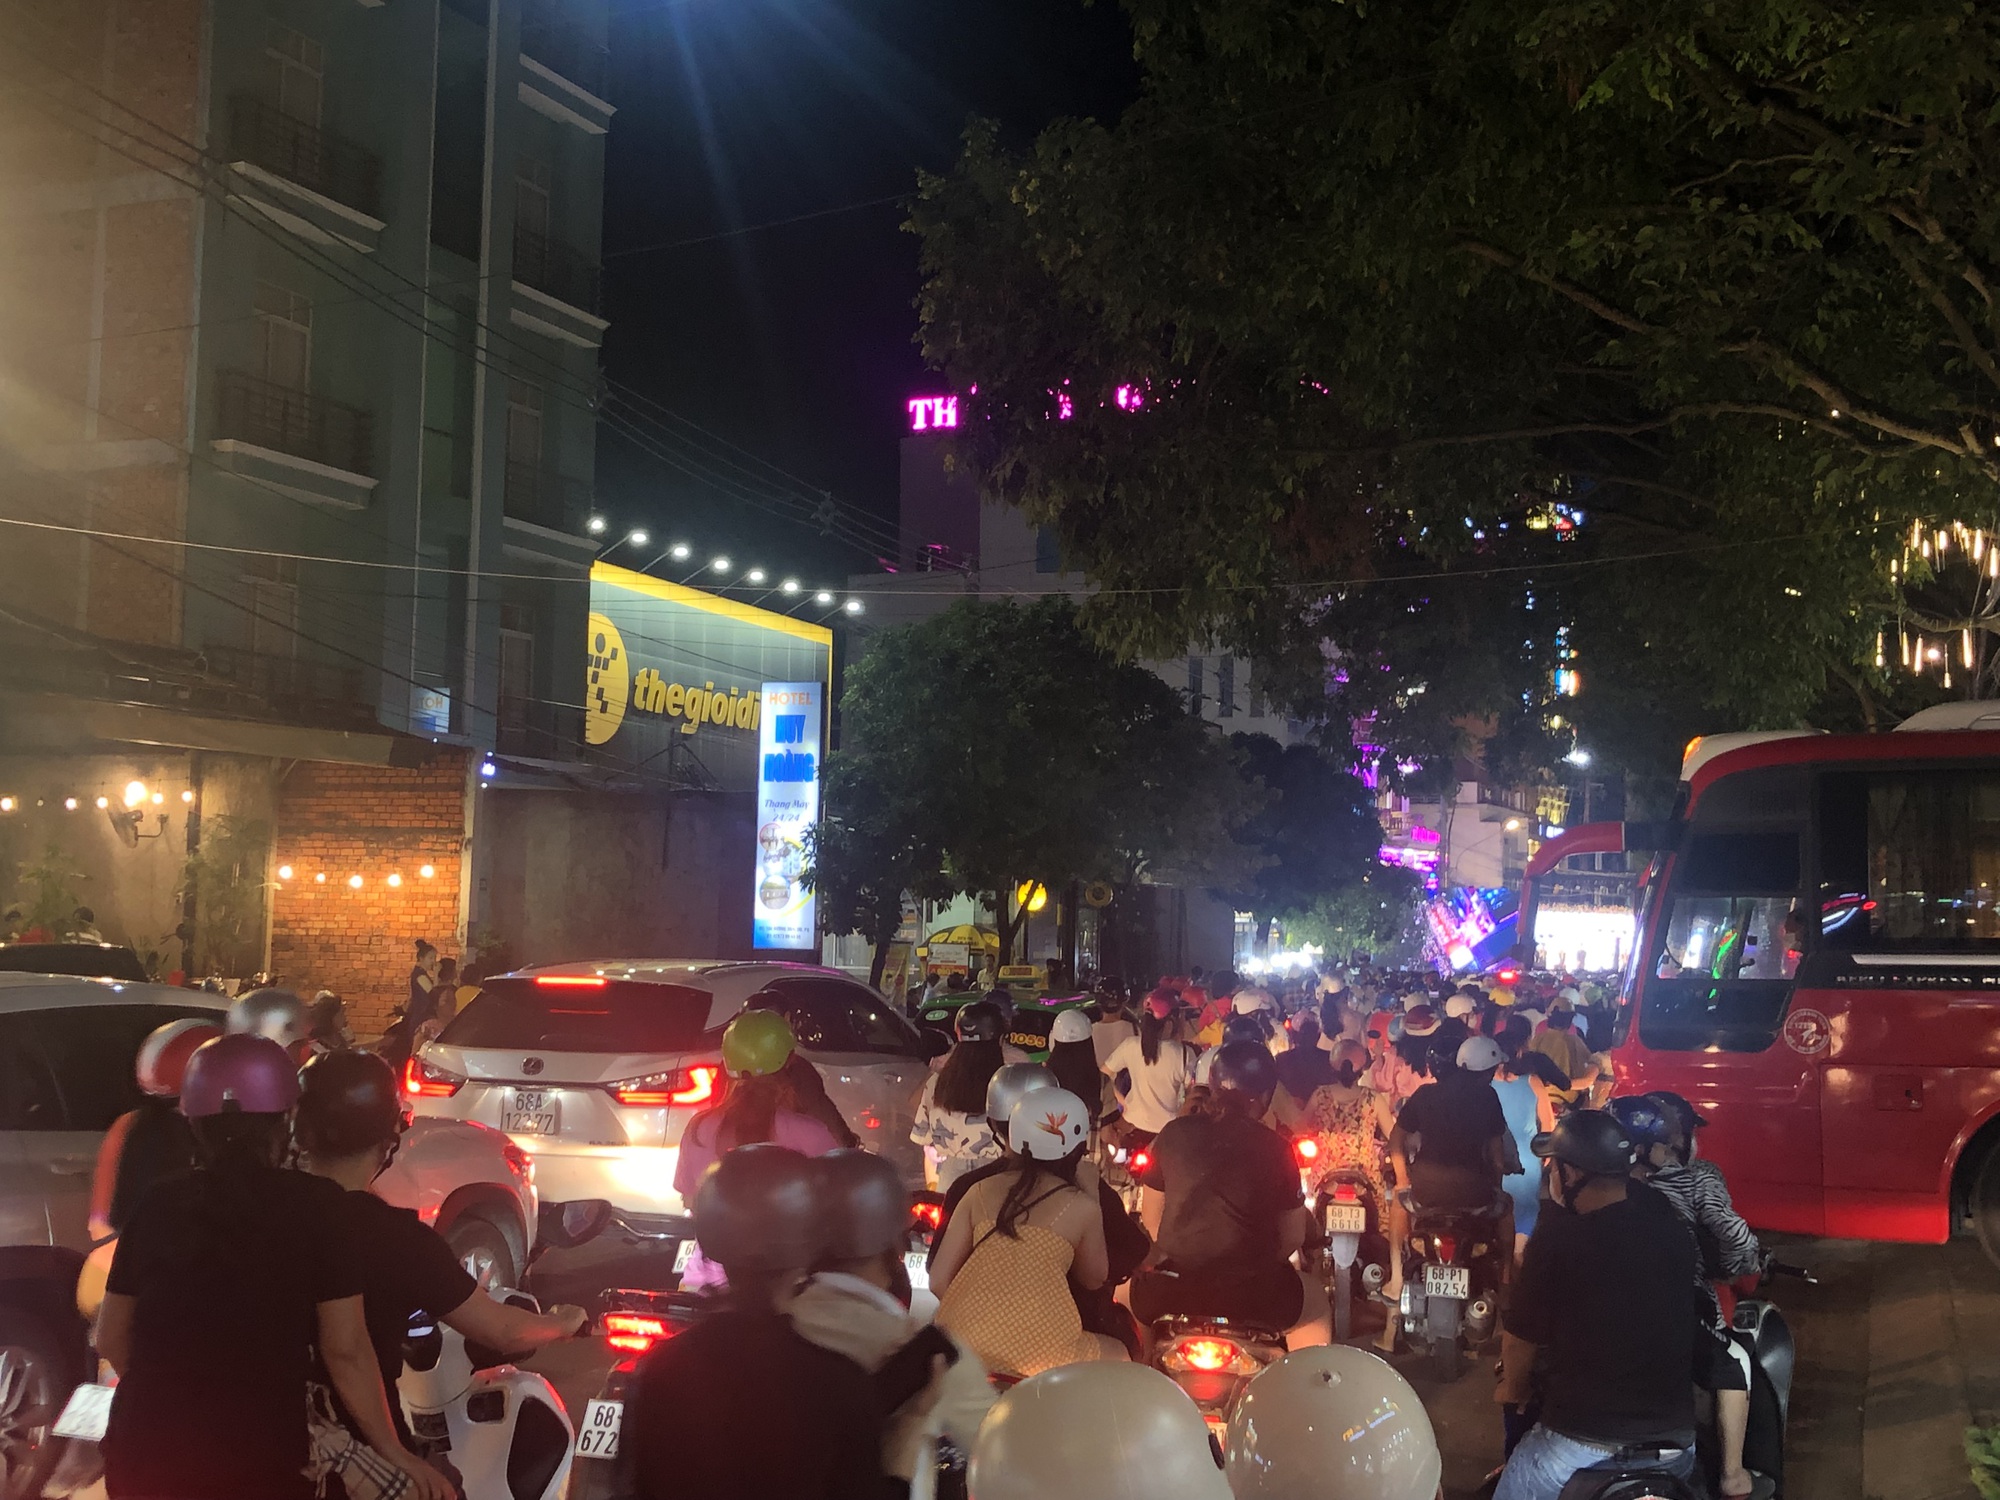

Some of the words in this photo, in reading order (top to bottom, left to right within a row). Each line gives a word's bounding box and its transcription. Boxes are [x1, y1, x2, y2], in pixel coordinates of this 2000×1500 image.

[634, 667, 761, 734] thegioidi
[769, 692, 812, 706] HOTEL
[775, 714, 806, 744] HUY
[1010, 1032, 1046, 1048] 1055
[515, 1093, 542, 1111] 68A
[1432, 1267, 1462, 1281] 68-P1
